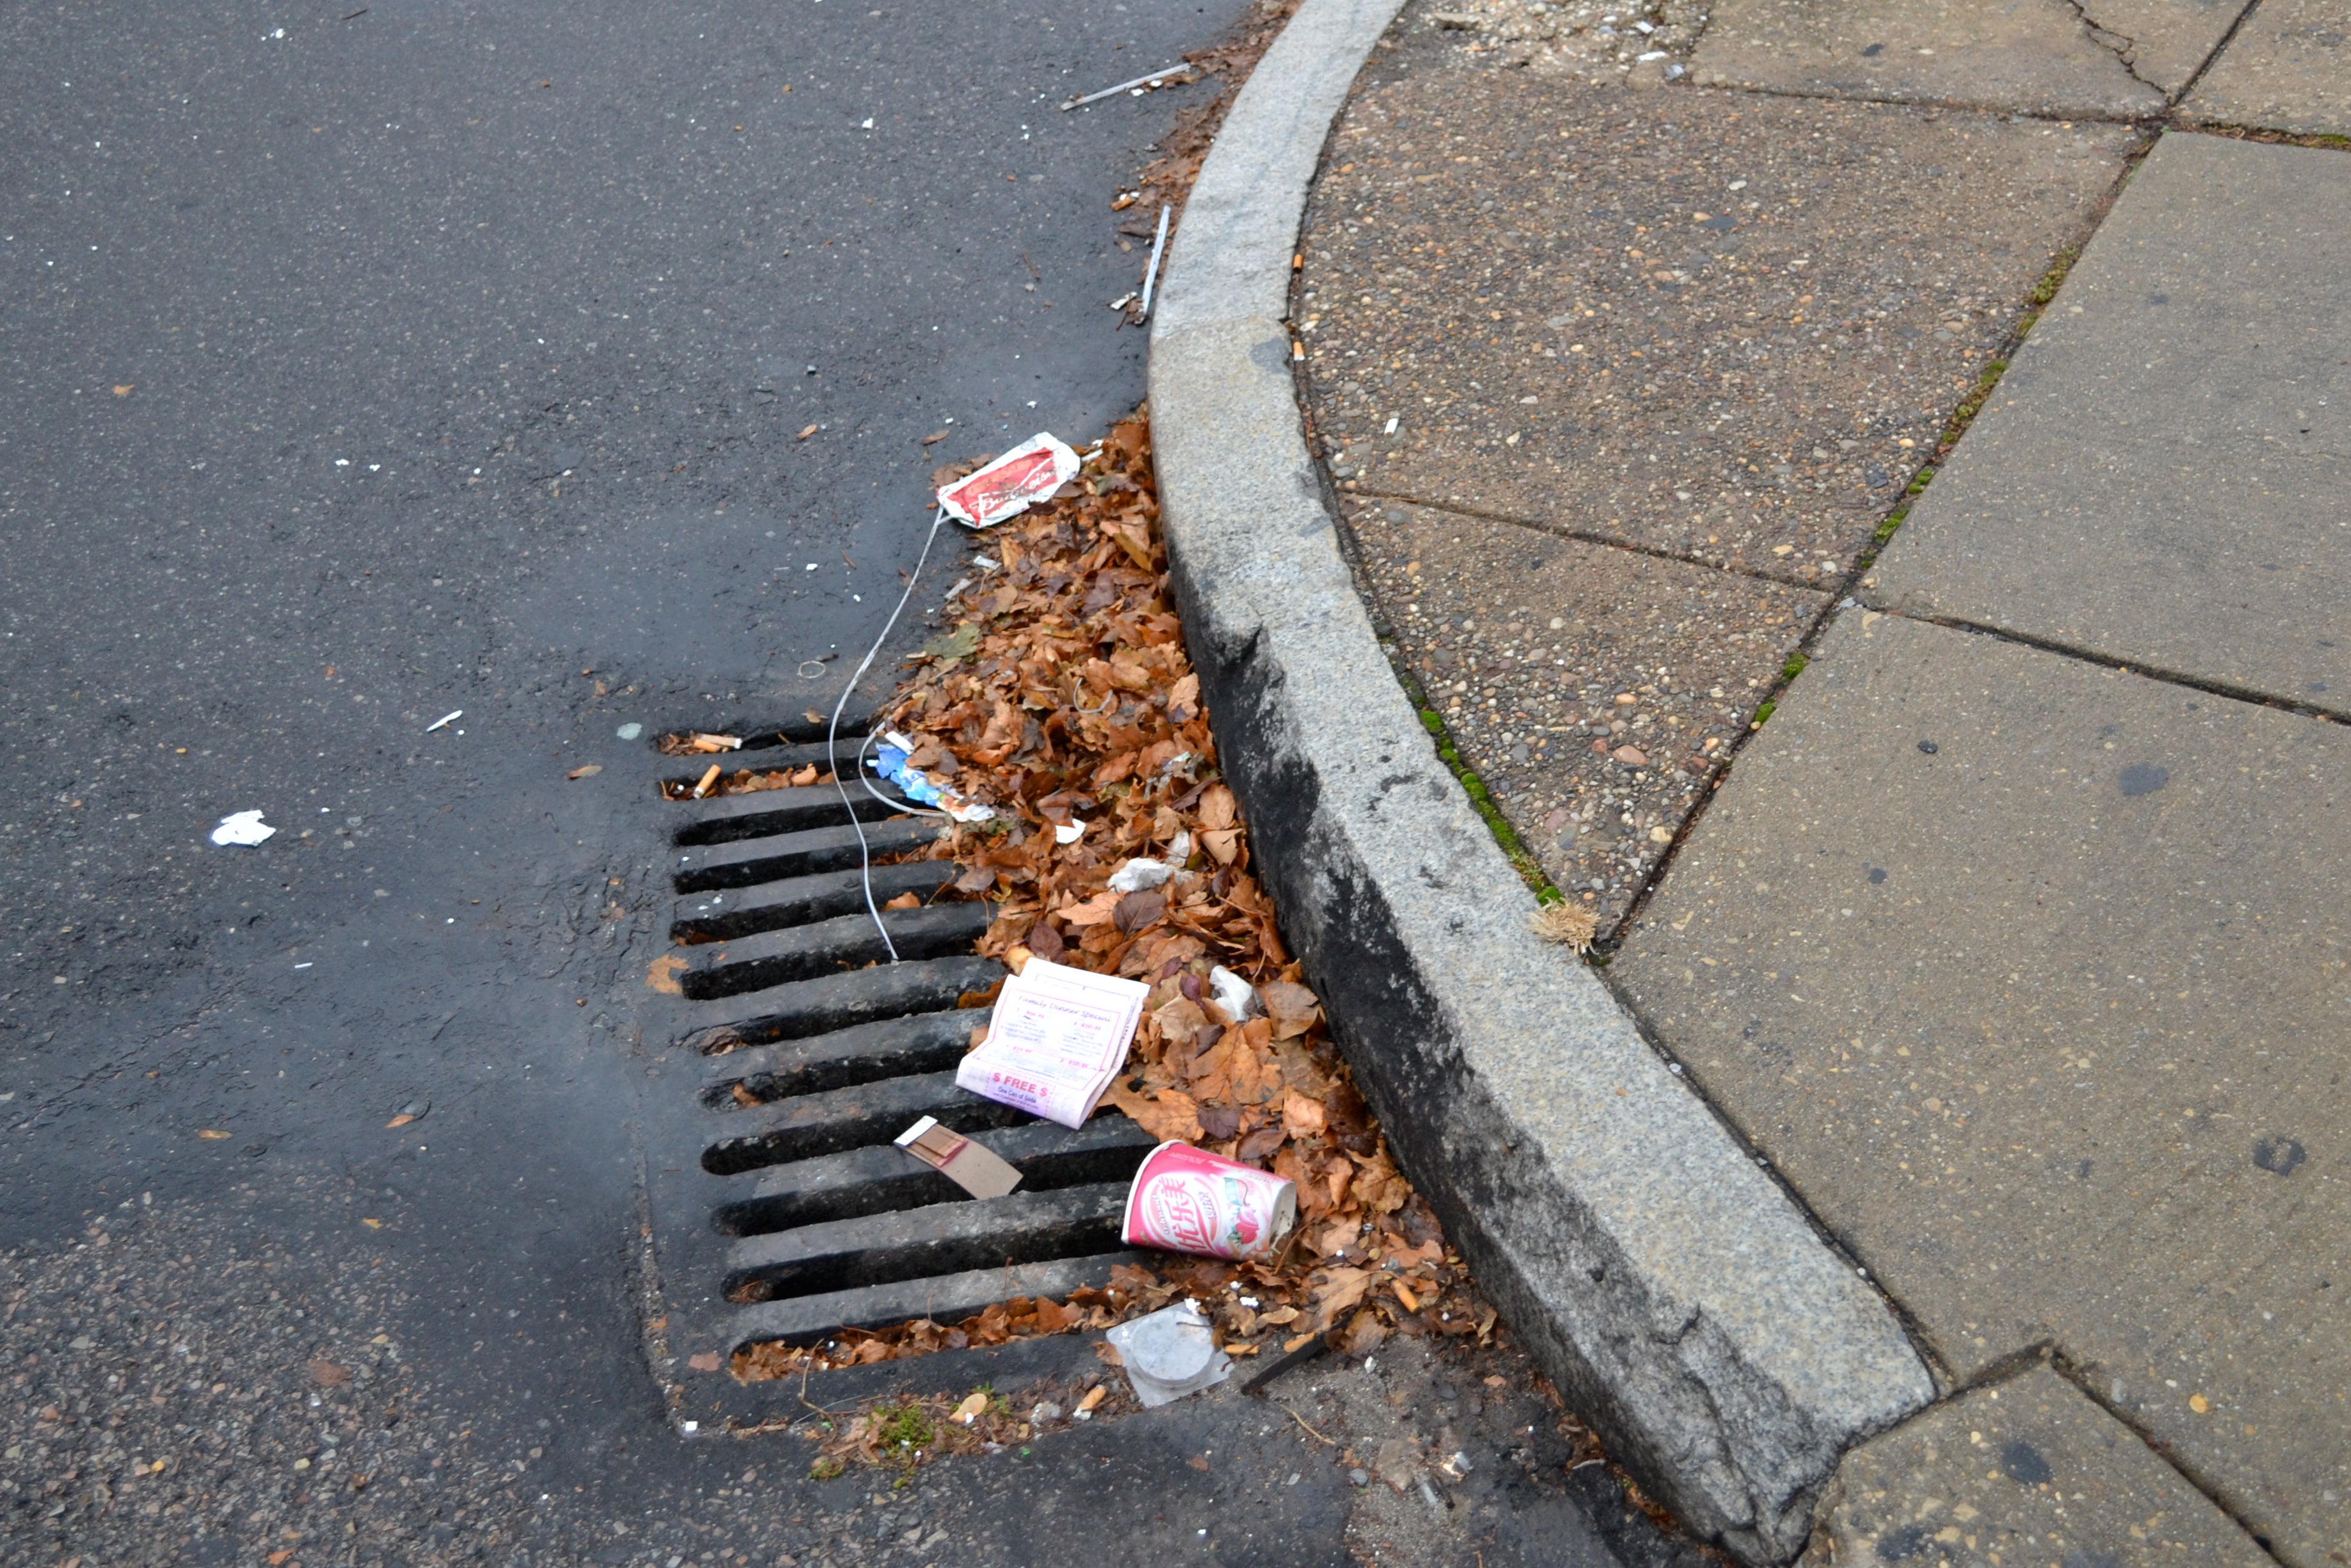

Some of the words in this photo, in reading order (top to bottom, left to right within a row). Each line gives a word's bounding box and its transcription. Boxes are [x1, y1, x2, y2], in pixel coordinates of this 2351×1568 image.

[969, 470, 1056, 517] Budeis
[1018, 996, 1047, 1009] Family
[1049, 998, 1079, 1015] Dinner
[1080, 1009, 1113, 1023] Special
[1004, 1075, 1036, 1093] FREE
[1008, 1089, 1019, 1098] Can
[1024, 1093, 1037, 1104] Soda
[1159, 1176, 1206, 1250] 优乐美
